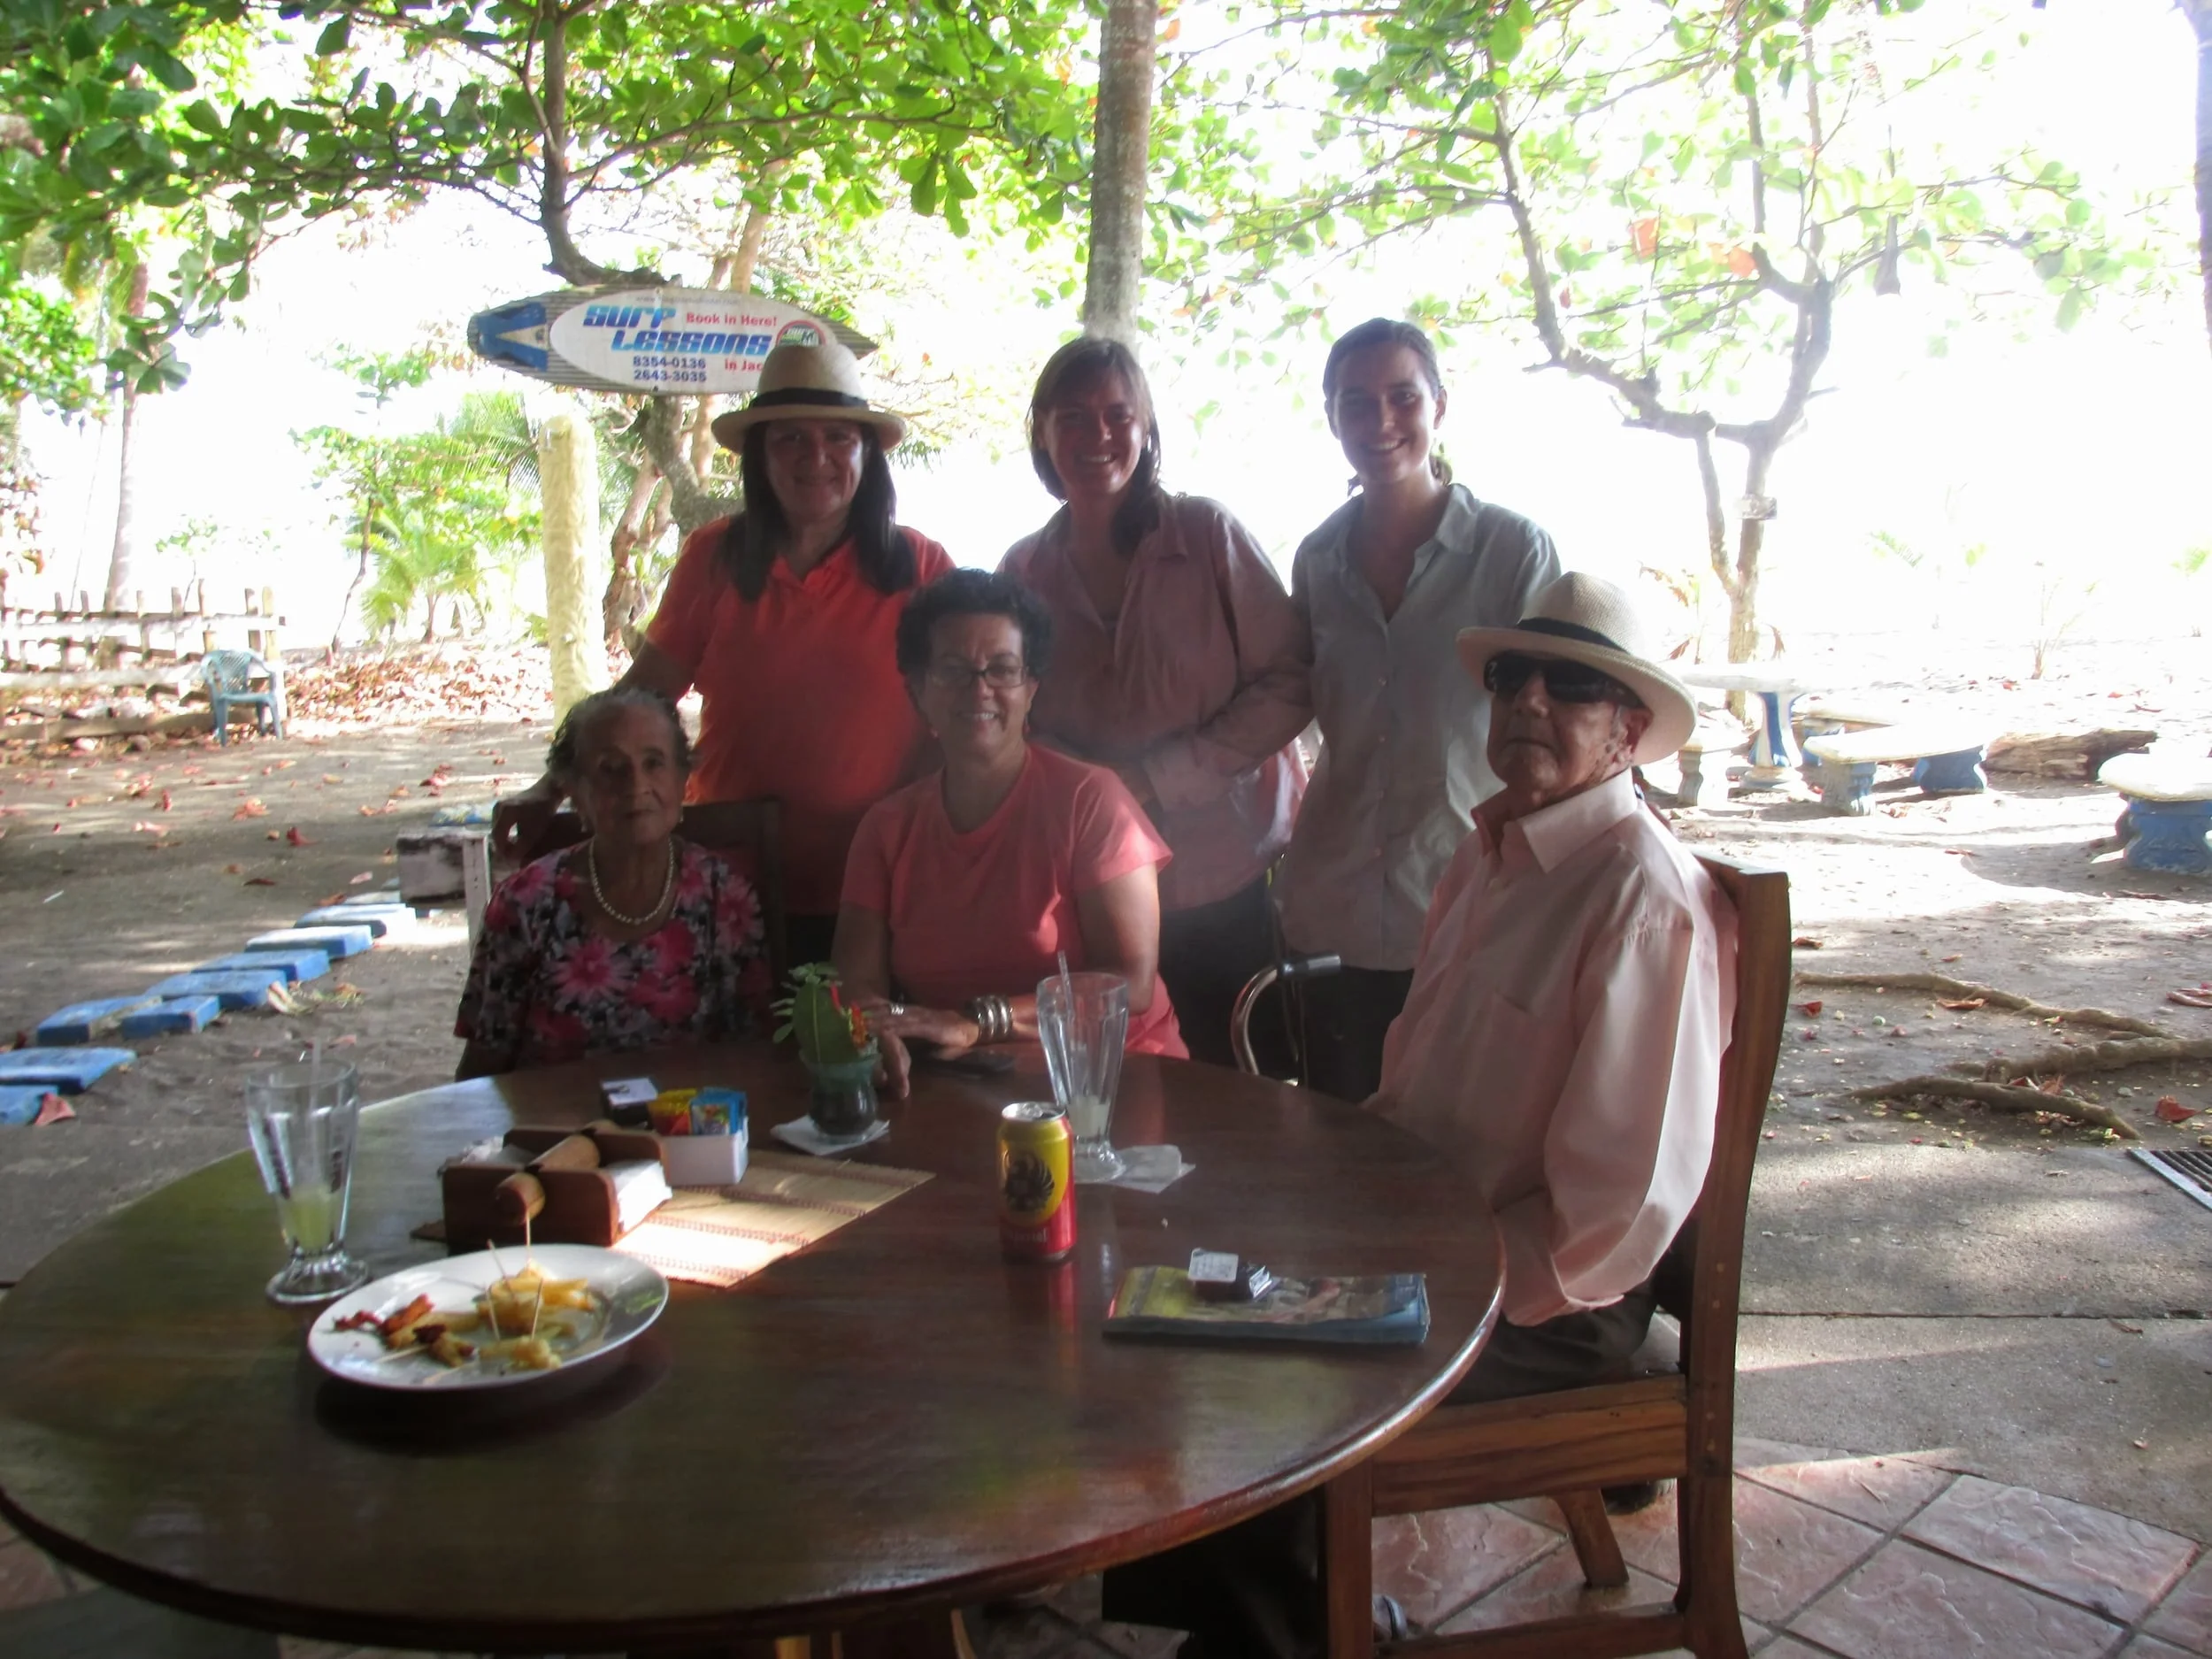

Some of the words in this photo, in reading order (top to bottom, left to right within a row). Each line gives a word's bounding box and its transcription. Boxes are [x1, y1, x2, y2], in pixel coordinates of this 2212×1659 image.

[686, 311, 720, 324] Book
[724, 313, 737, 325] in
[741, 314, 778, 326] Here!
[611, 329, 772, 356] Lessons
[724, 358, 737, 370] in
[741, 359, 764, 372] Jac
